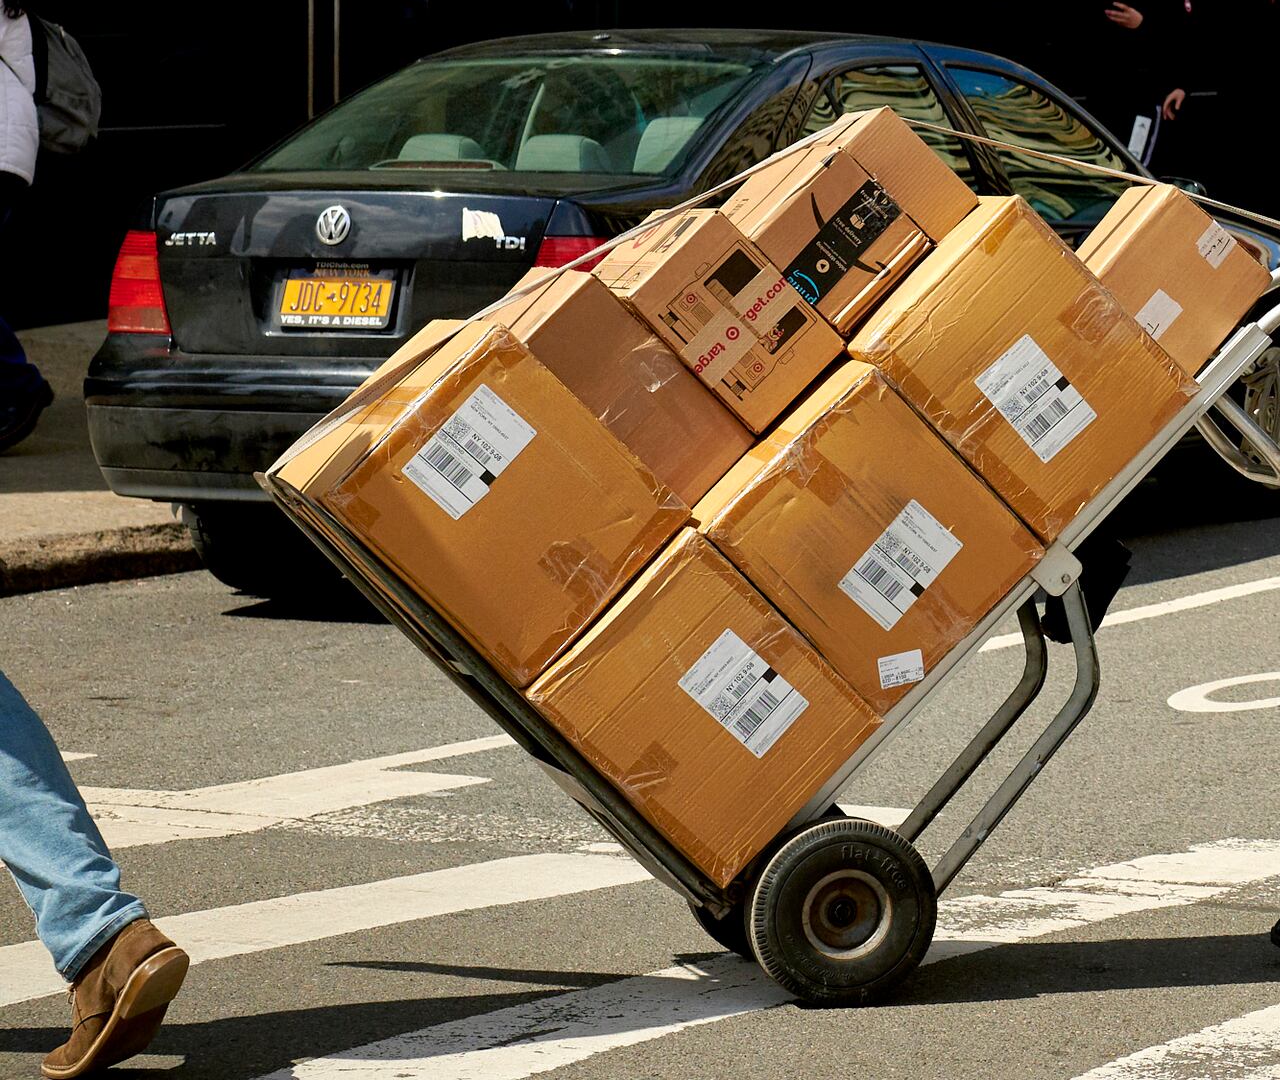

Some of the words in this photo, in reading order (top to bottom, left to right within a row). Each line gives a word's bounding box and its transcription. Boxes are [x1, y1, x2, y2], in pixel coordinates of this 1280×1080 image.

[165, 232, 216, 247] JETTA
[843, 226, 862, 244] delivery
[495, 235, 526, 251] TDI
[316, 261, 369, 269] TDIClub.com
[280, 315, 305, 325] YES,
[308, 316, 329, 325] IT'S
[331, 316, 340, 325] A
[343, 317, 383, 326] DIESEL
